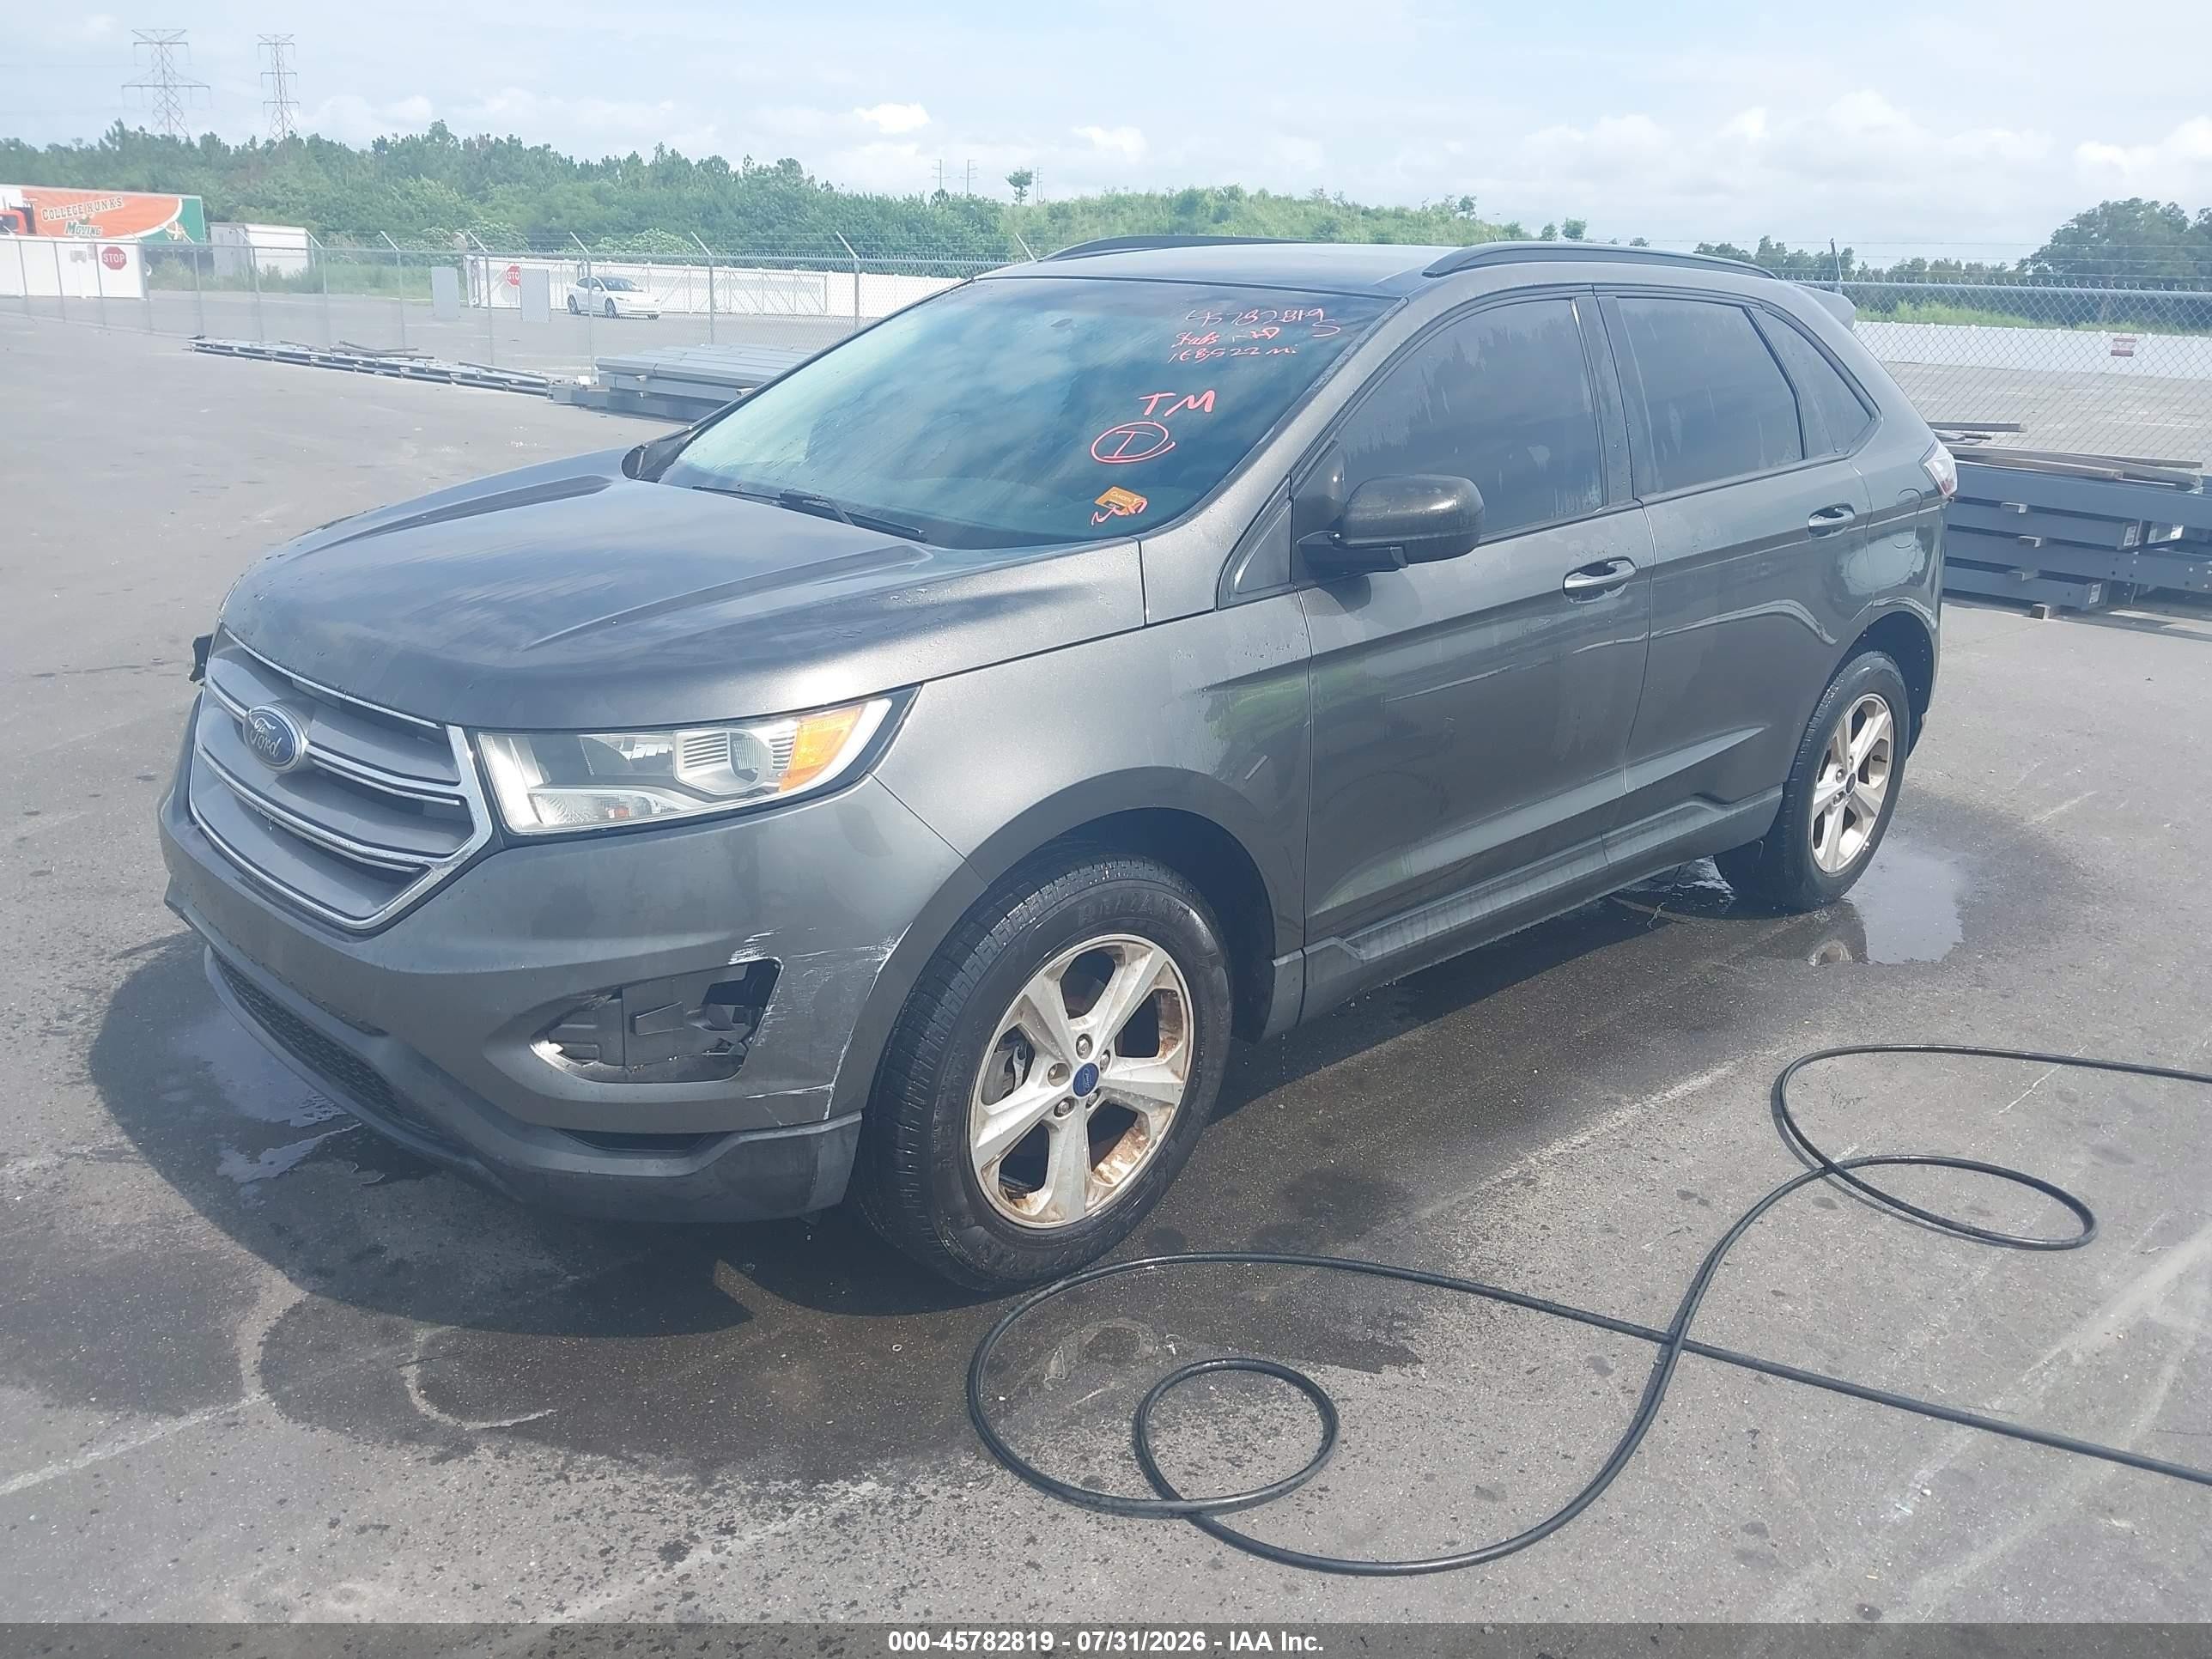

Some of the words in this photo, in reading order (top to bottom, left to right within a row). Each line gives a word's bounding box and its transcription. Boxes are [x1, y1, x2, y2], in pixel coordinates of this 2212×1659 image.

[41, 204, 84, 221] COLLEGE
[87, 197, 123, 214] HUNKS
[65, 221, 102, 235] MOVING
[103, 253, 125, 263] STOP
[250, 717, 283, 757] Ford
